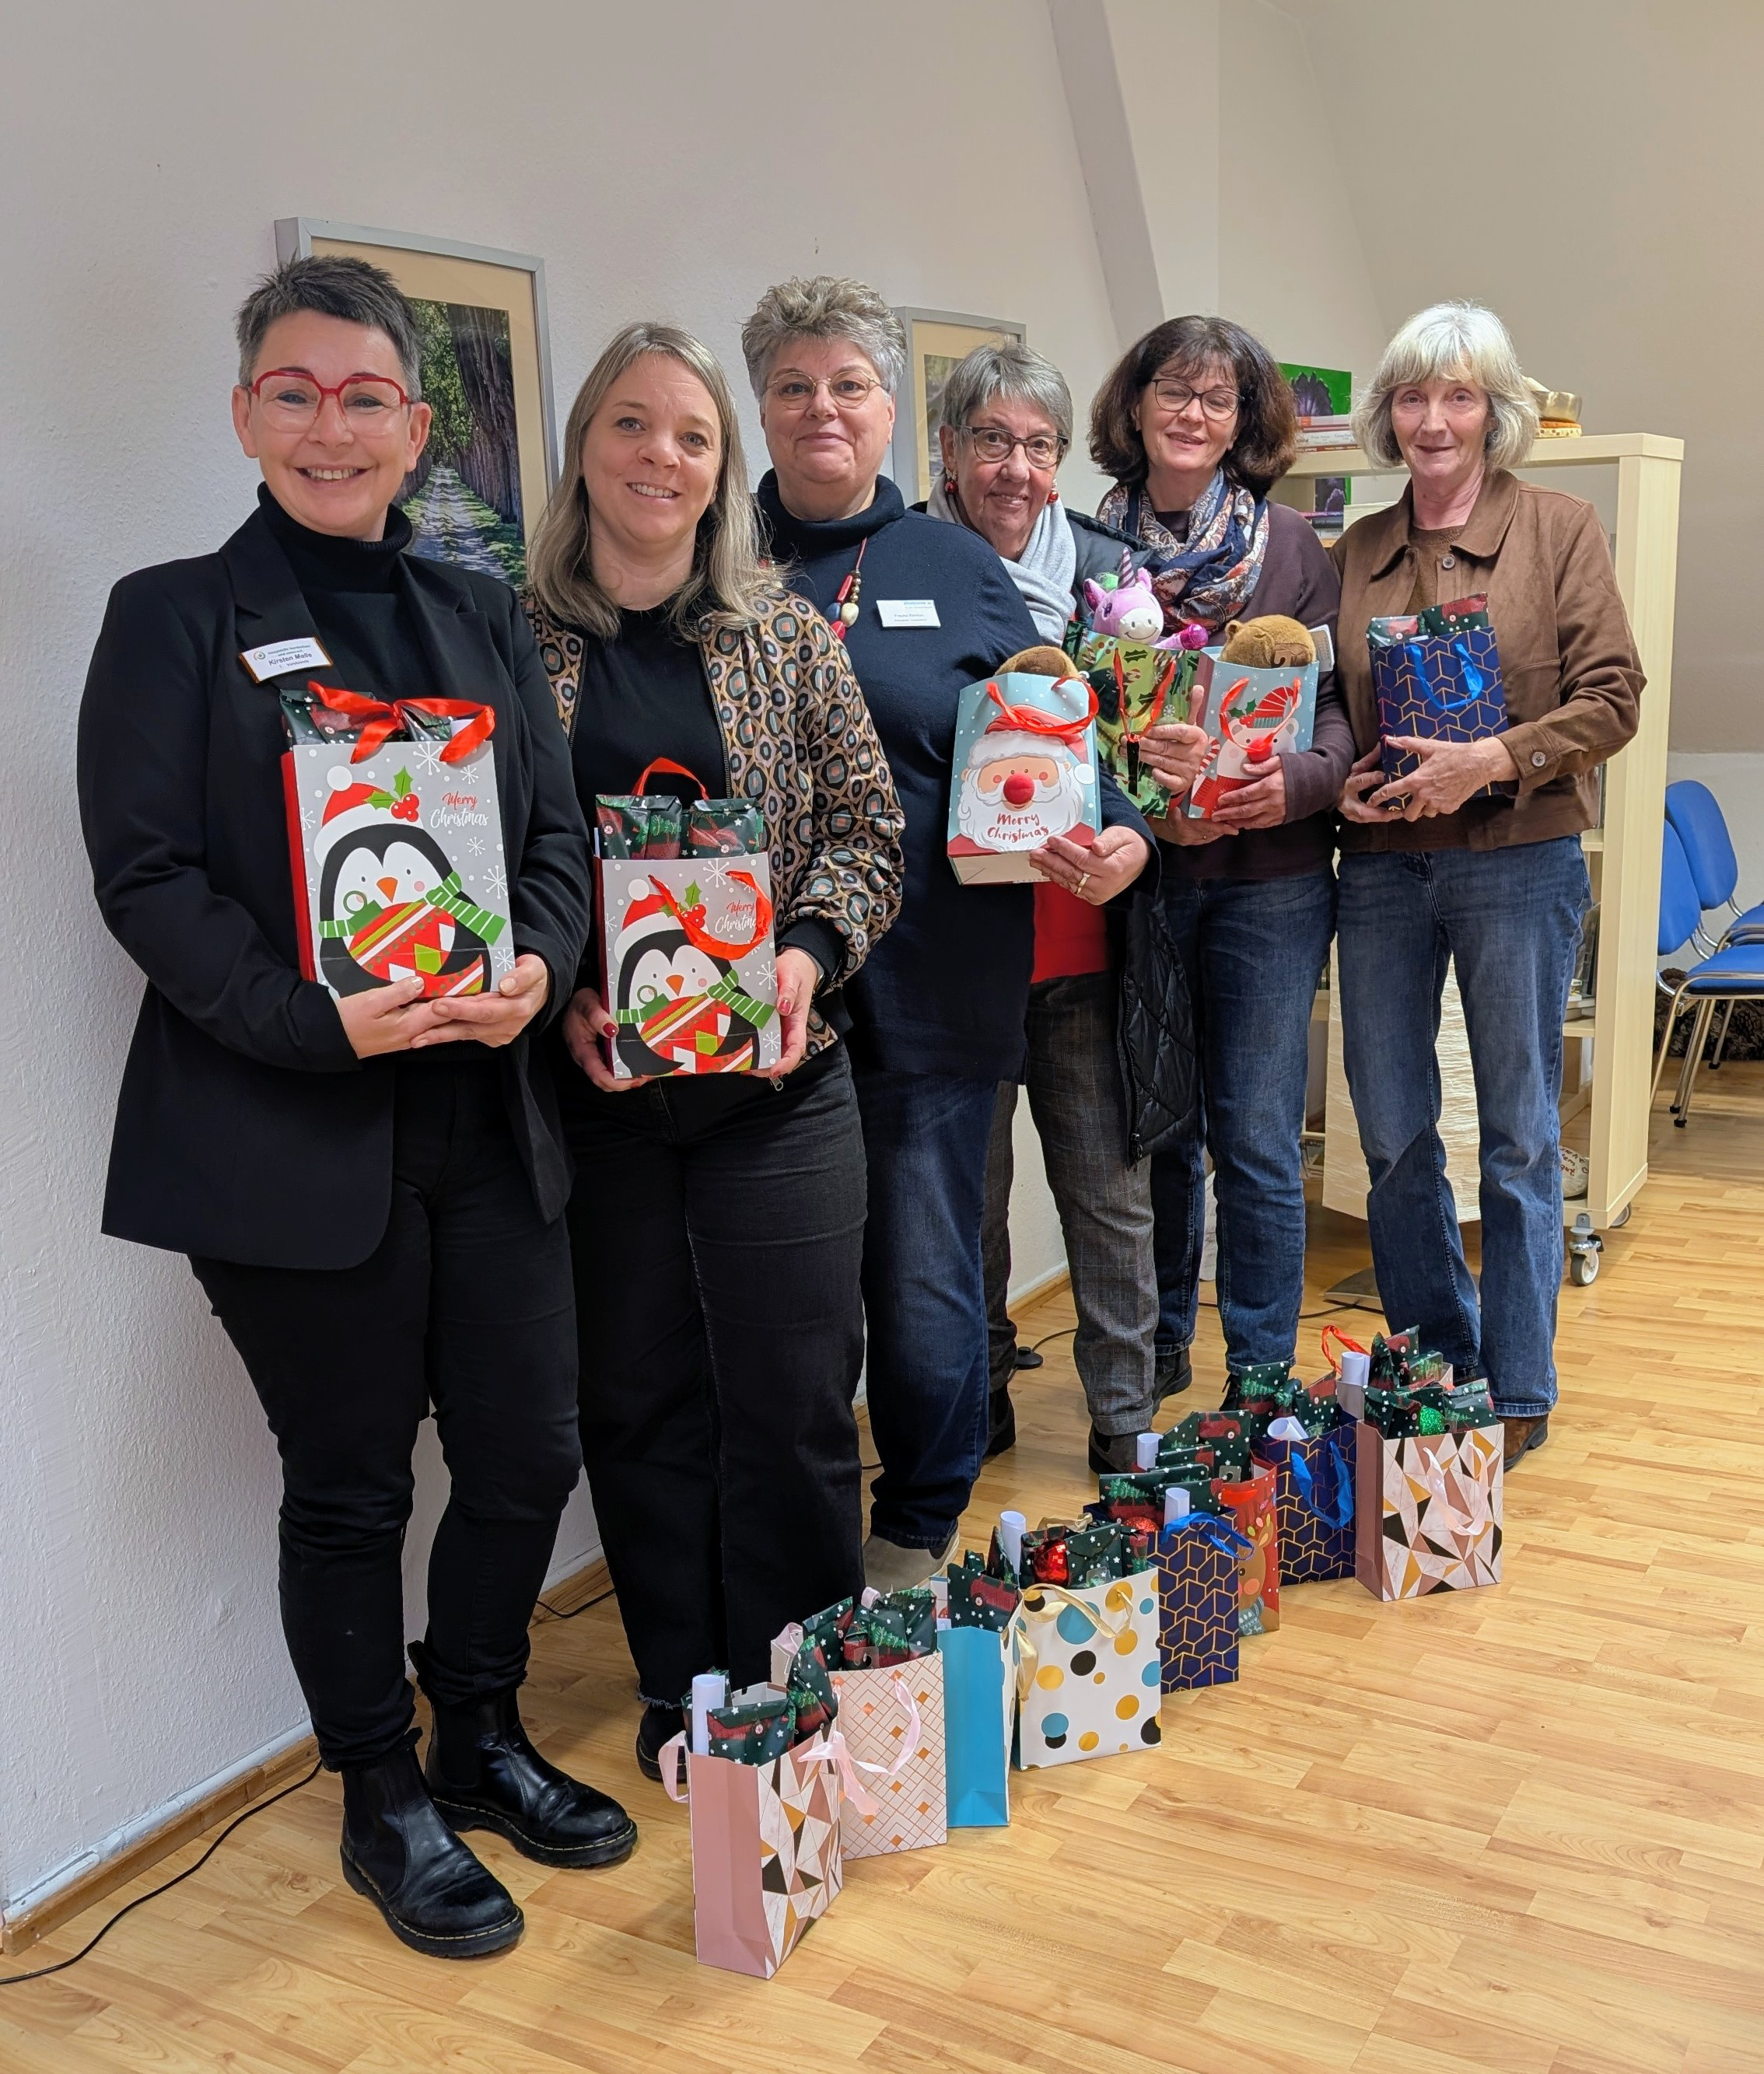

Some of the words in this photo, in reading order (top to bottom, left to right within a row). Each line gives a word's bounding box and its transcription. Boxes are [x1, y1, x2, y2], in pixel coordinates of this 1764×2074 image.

[442, 790, 478, 811] Merry
[429, 806, 490, 829] Christmas
[996, 813, 1040, 827] Merry
[987, 826, 1049, 844] Christmas
[726, 899, 755, 918] Merry
[714, 914, 757, 934] Christm
